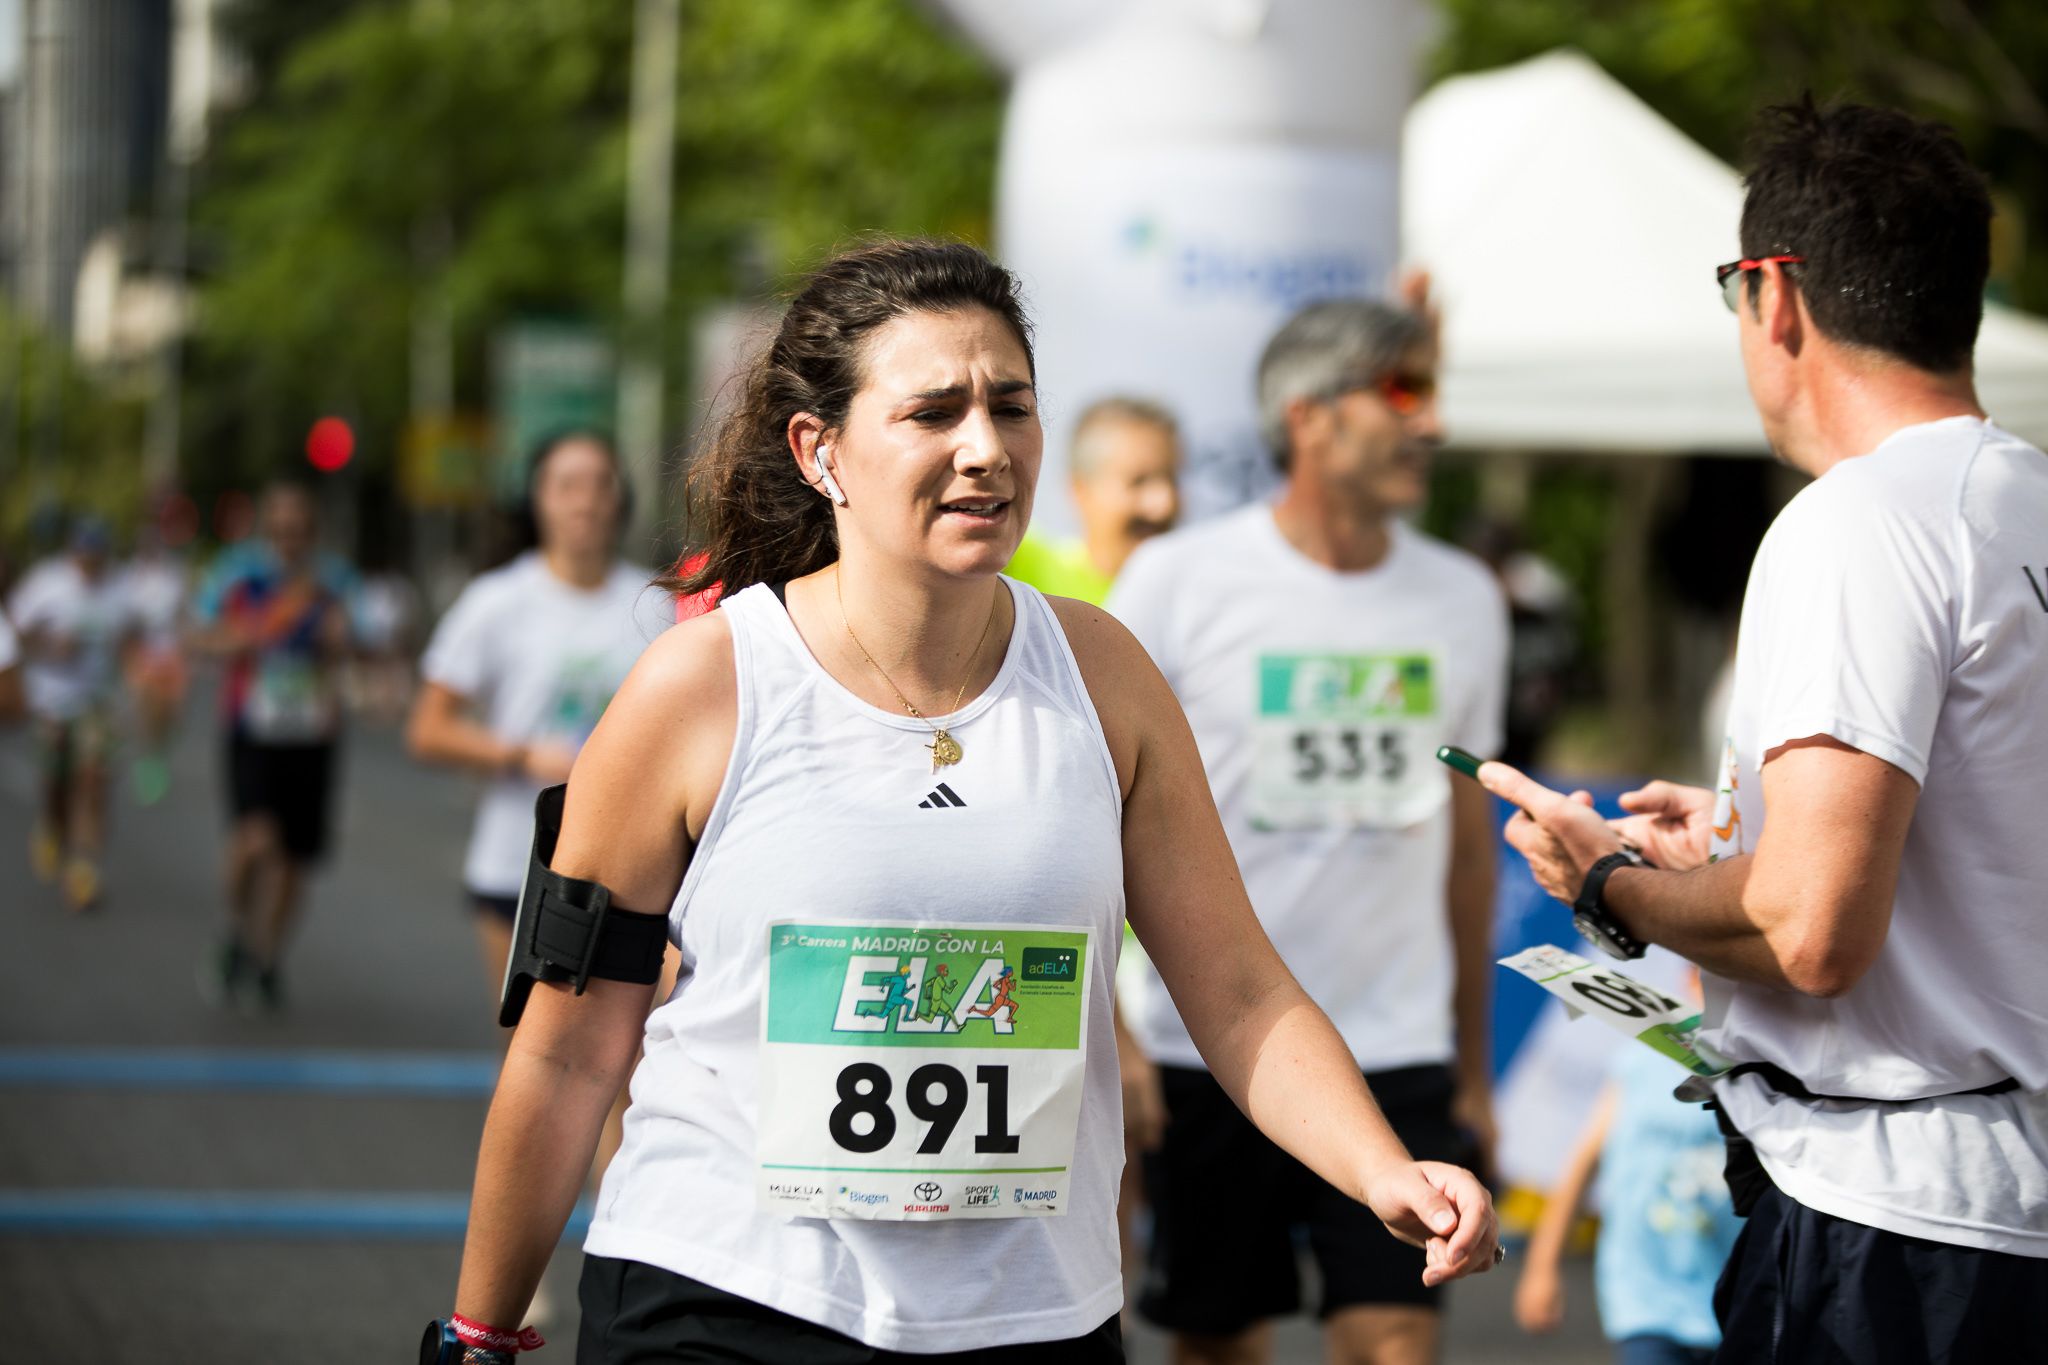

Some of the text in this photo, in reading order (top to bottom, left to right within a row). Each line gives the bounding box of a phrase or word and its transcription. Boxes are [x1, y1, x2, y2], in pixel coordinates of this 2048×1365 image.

[1294, 729, 1407, 785] 535
[799, 936, 847, 948] Carrera
[852, 936, 930, 952] MADRID
[935, 938, 976, 953] CON
[980, 940, 1005, 954] LA
[832, 955, 1014, 1034] ELA
[829, 1062, 1020, 1154] 891
[850, 1191, 889, 1205] Biogen
[965, 1185, 994, 1195] SPORT
[1023, 1190, 1057, 1201] MADRID
[967, 1195, 990, 1205] LIFE
